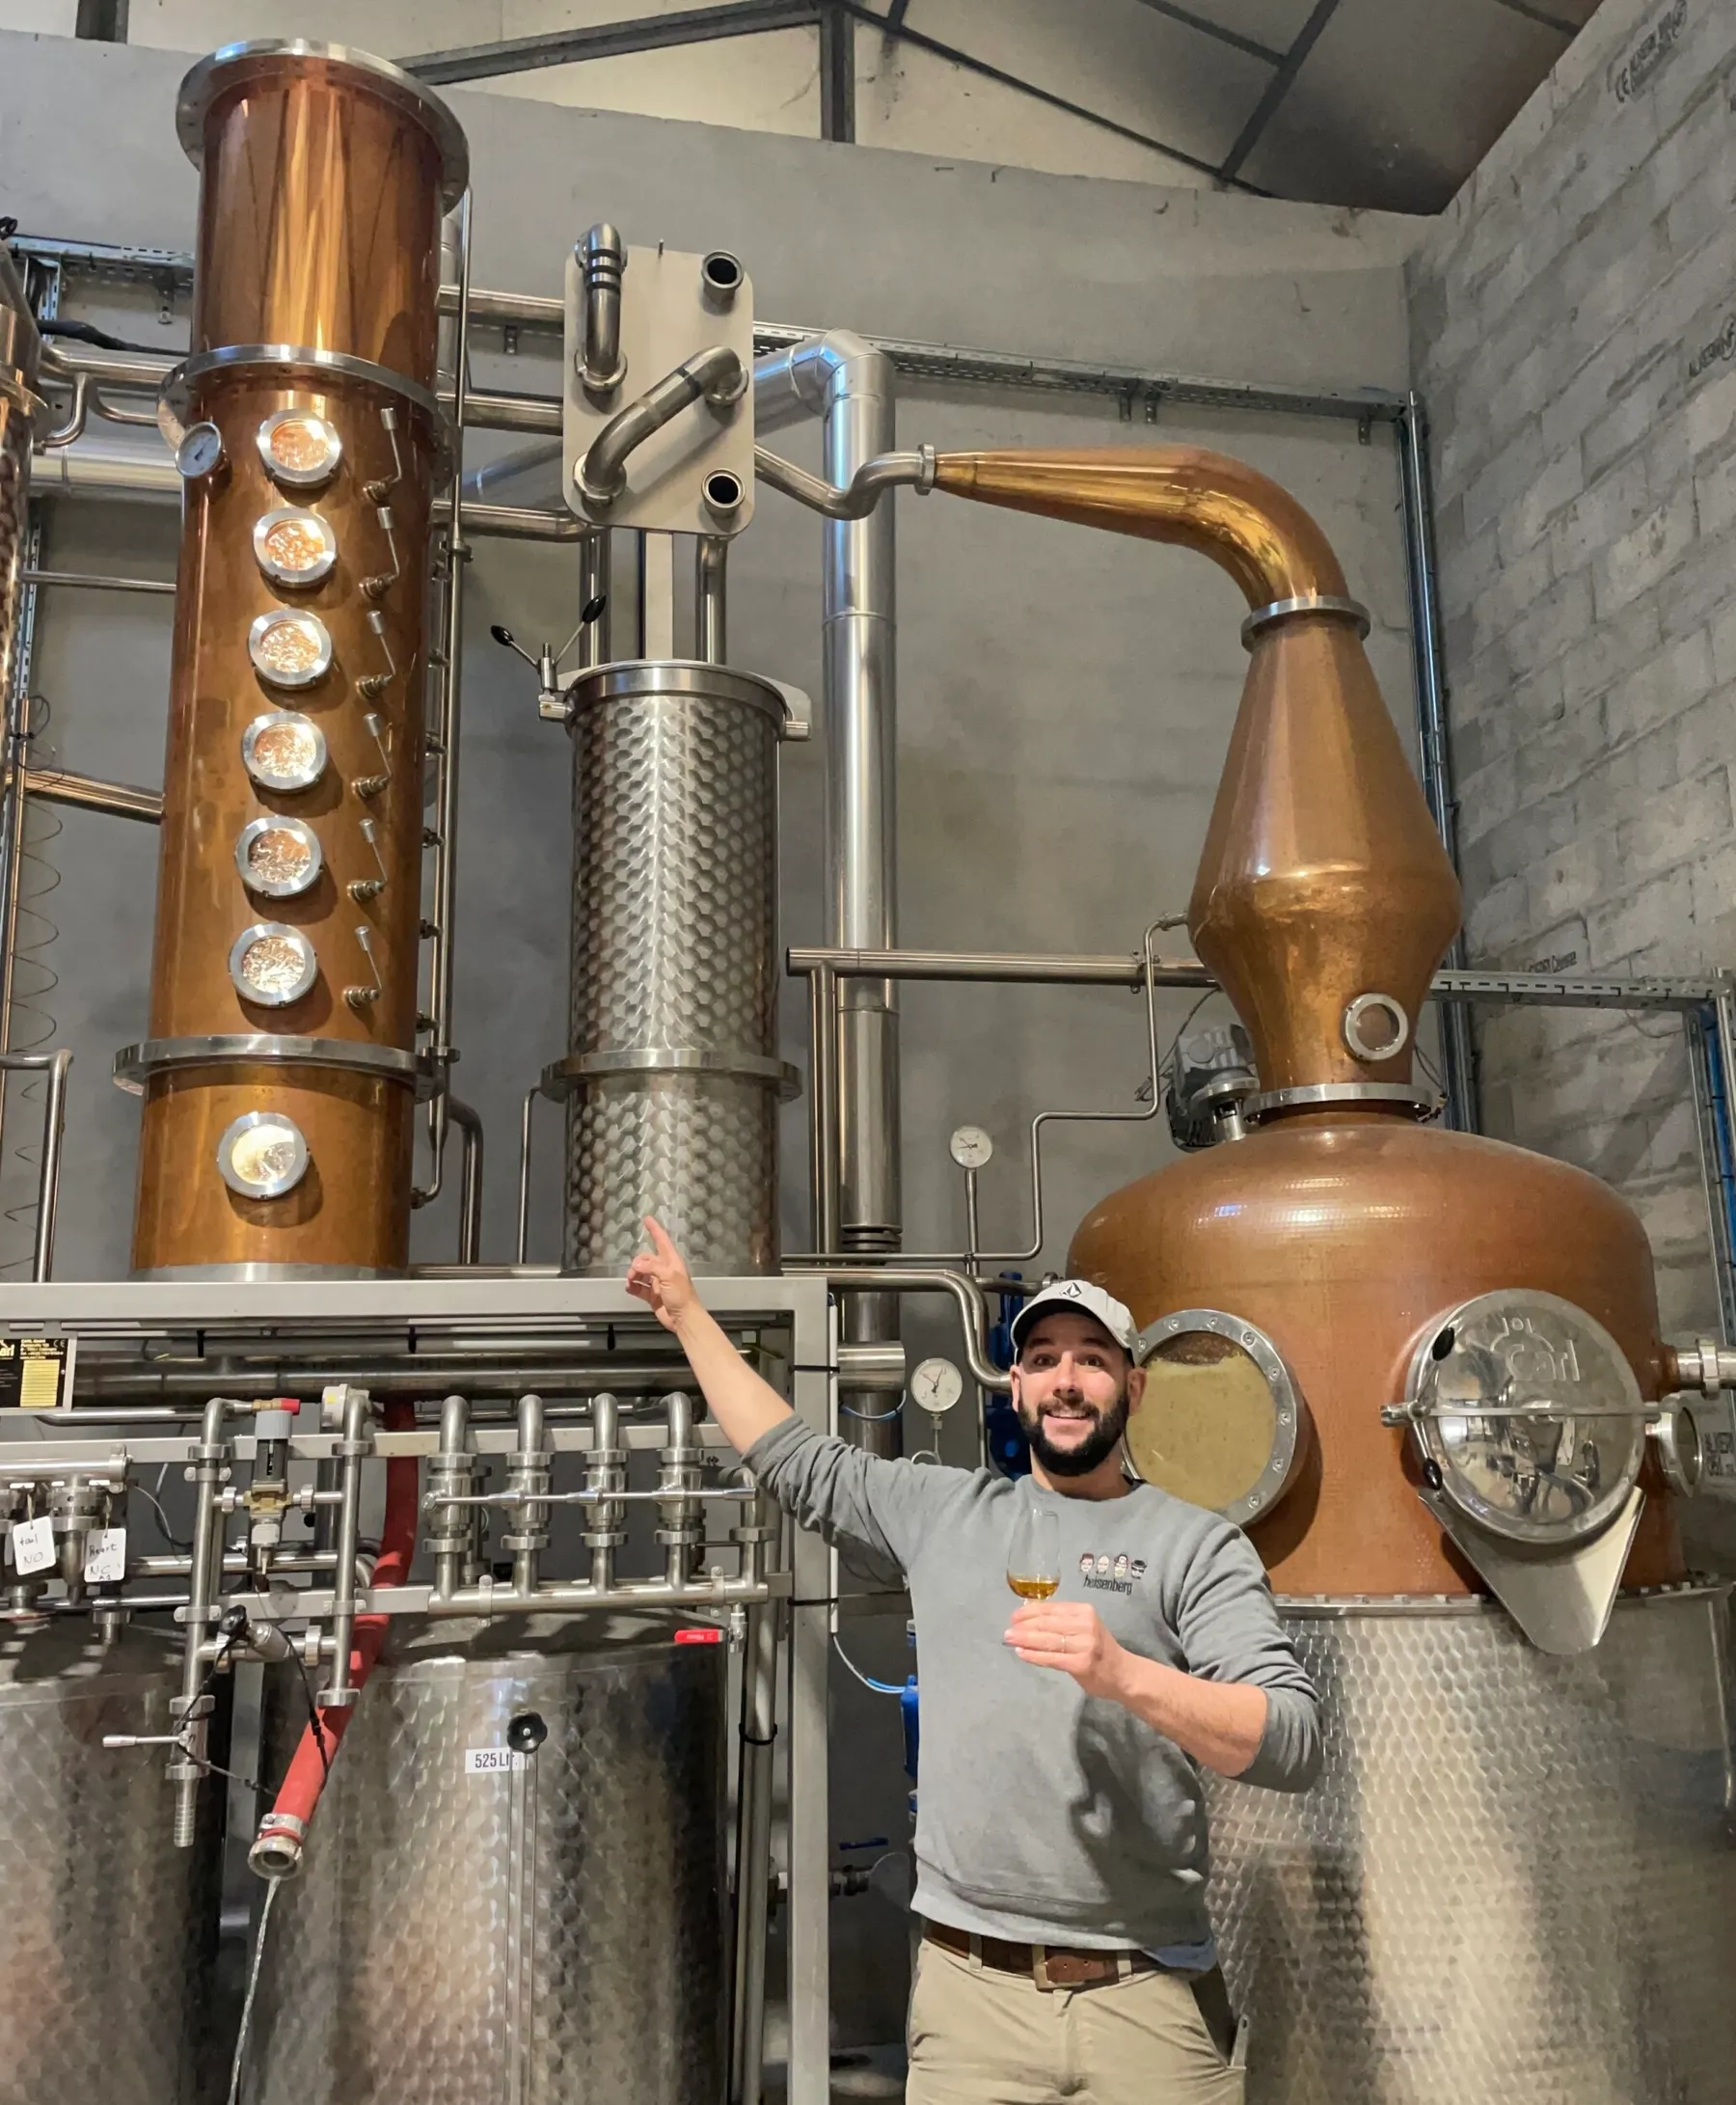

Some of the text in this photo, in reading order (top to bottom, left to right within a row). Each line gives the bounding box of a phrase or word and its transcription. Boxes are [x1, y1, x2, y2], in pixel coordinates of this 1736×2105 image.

[0, 1344, 14, 1356] arl
[53, 1339, 67, 1348] CE
[1505, 1338, 1581, 1381] Carl
[19, 1533, 38, 1545] tail
[23, 1551, 43, 1565] NO
[1084, 1574, 1132, 1596] heisenberg
[475, 1753, 497, 1768] 525
